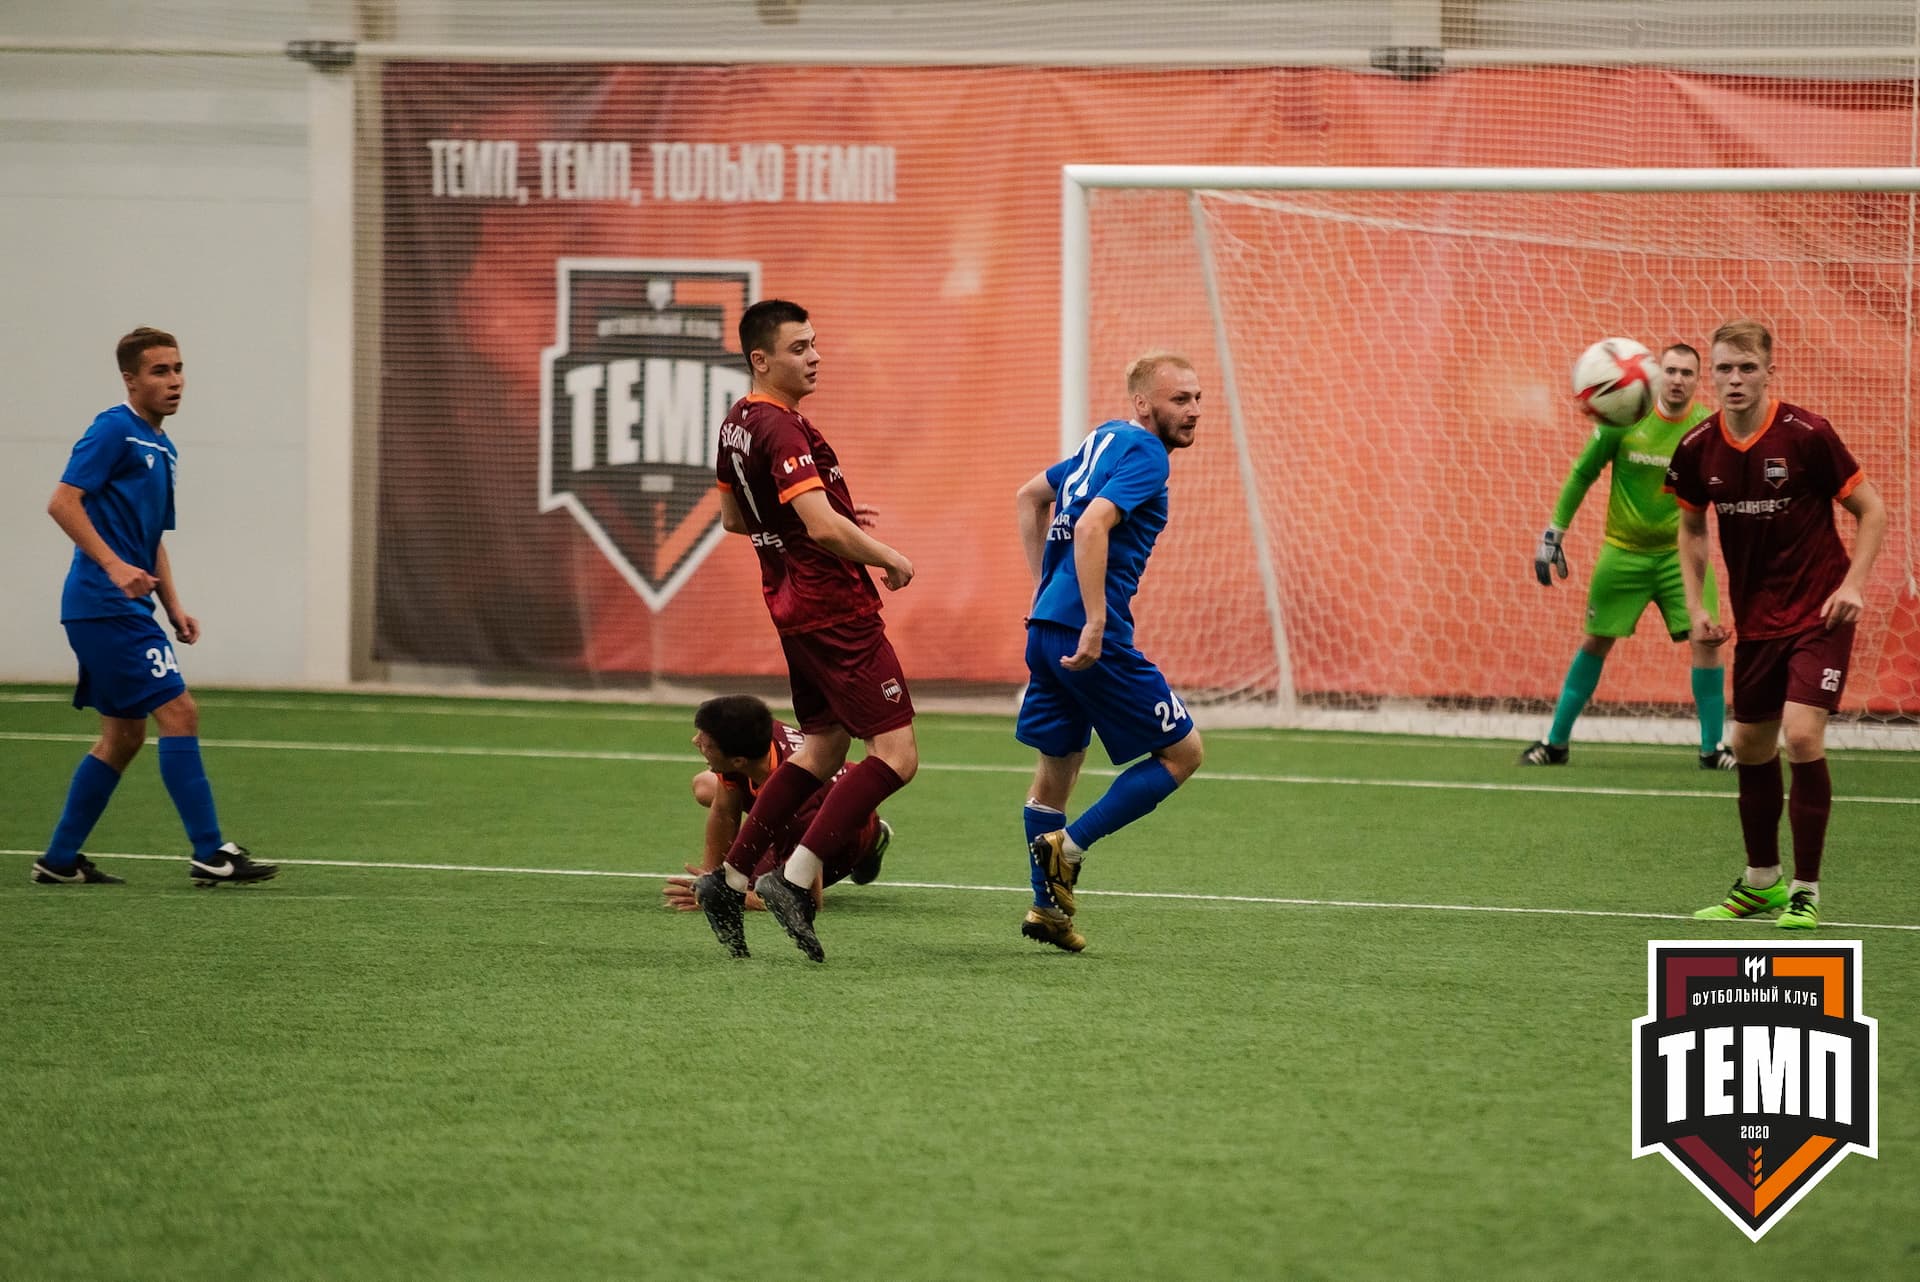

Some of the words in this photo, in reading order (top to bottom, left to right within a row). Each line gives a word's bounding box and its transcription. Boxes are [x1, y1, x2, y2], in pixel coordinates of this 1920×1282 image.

[427, 139, 529, 205] ТЕМП,
[537, 141, 641, 207] ТЕМП,
[650, 142, 785, 202] ТОЛЬКО
[793, 145, 897, 203] ТЕМП!
[146, 645, 178, 678] 34
[1154, 691, 1187, 733] 24
